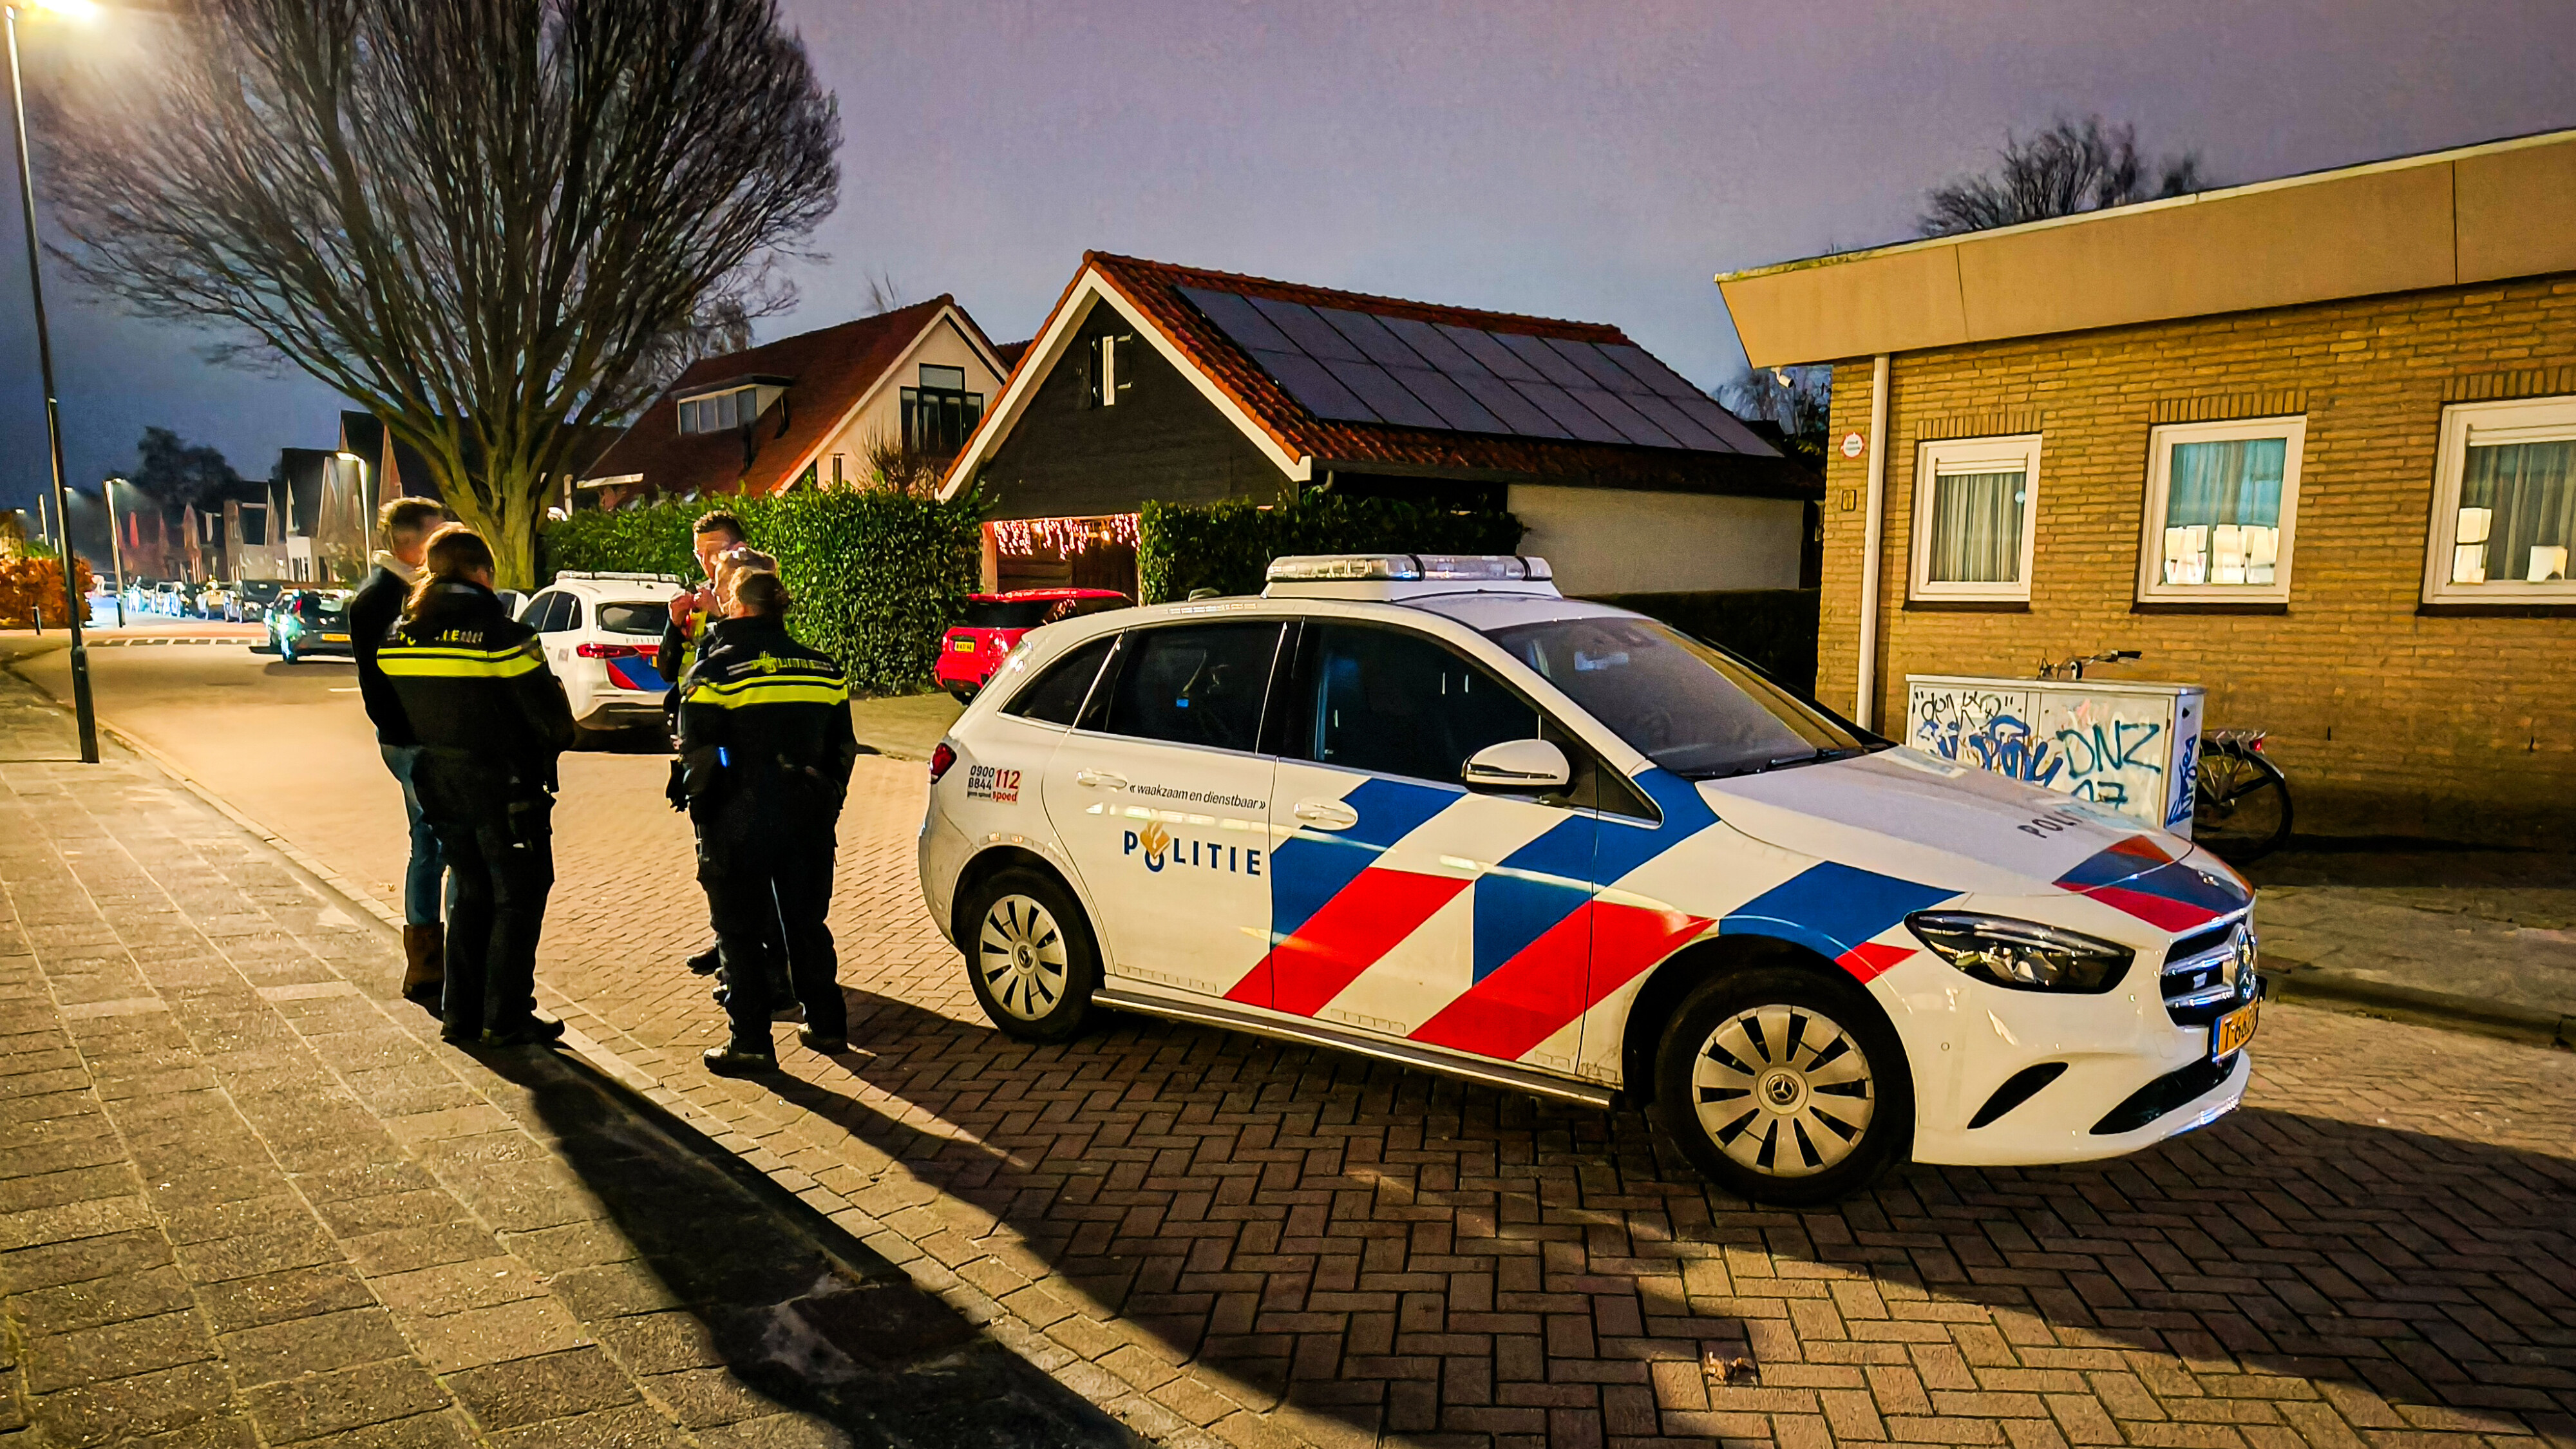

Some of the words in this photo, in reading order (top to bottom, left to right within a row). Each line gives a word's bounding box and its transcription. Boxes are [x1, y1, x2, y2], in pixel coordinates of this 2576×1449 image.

[2056, 720, 2162, 780] DNZ
[970, 765, 995, 777] 0900
[996, 768, 1021, 790] 112
[968, 777, 992, 791] 0844
[1137, 784, 1188, 800] waakzaam
[1191, 791, 1202, 802] en
[1204, 791, 1258, 810] dienstbaar
[1124, 830, 1261, 876] POLITIE
